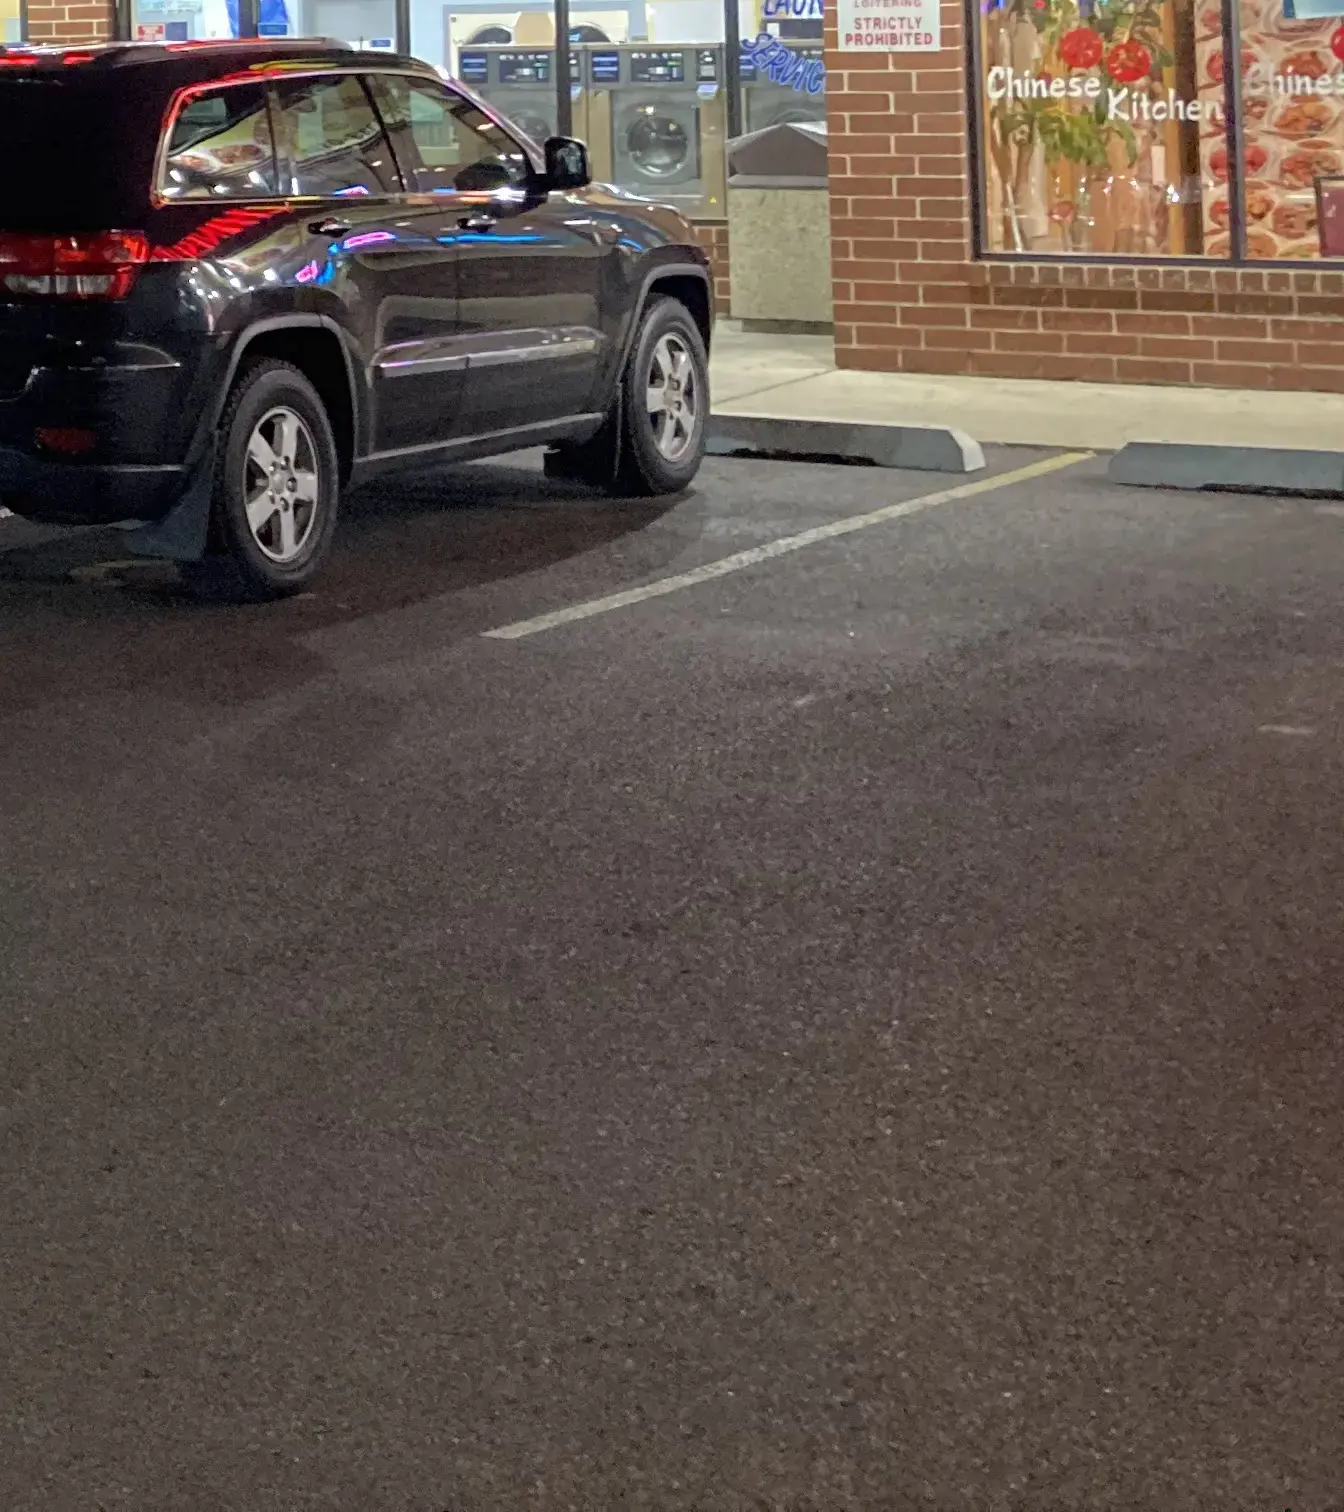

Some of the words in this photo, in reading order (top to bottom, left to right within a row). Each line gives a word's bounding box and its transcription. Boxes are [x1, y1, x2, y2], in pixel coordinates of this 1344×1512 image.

[853, 16, 923, 30] STRICTLY
[844, 32, 933, 46] PROHIBITED
[986, 65, 1101, 99] Chinese
[1106, 87, 1225, 122] Kitchen
